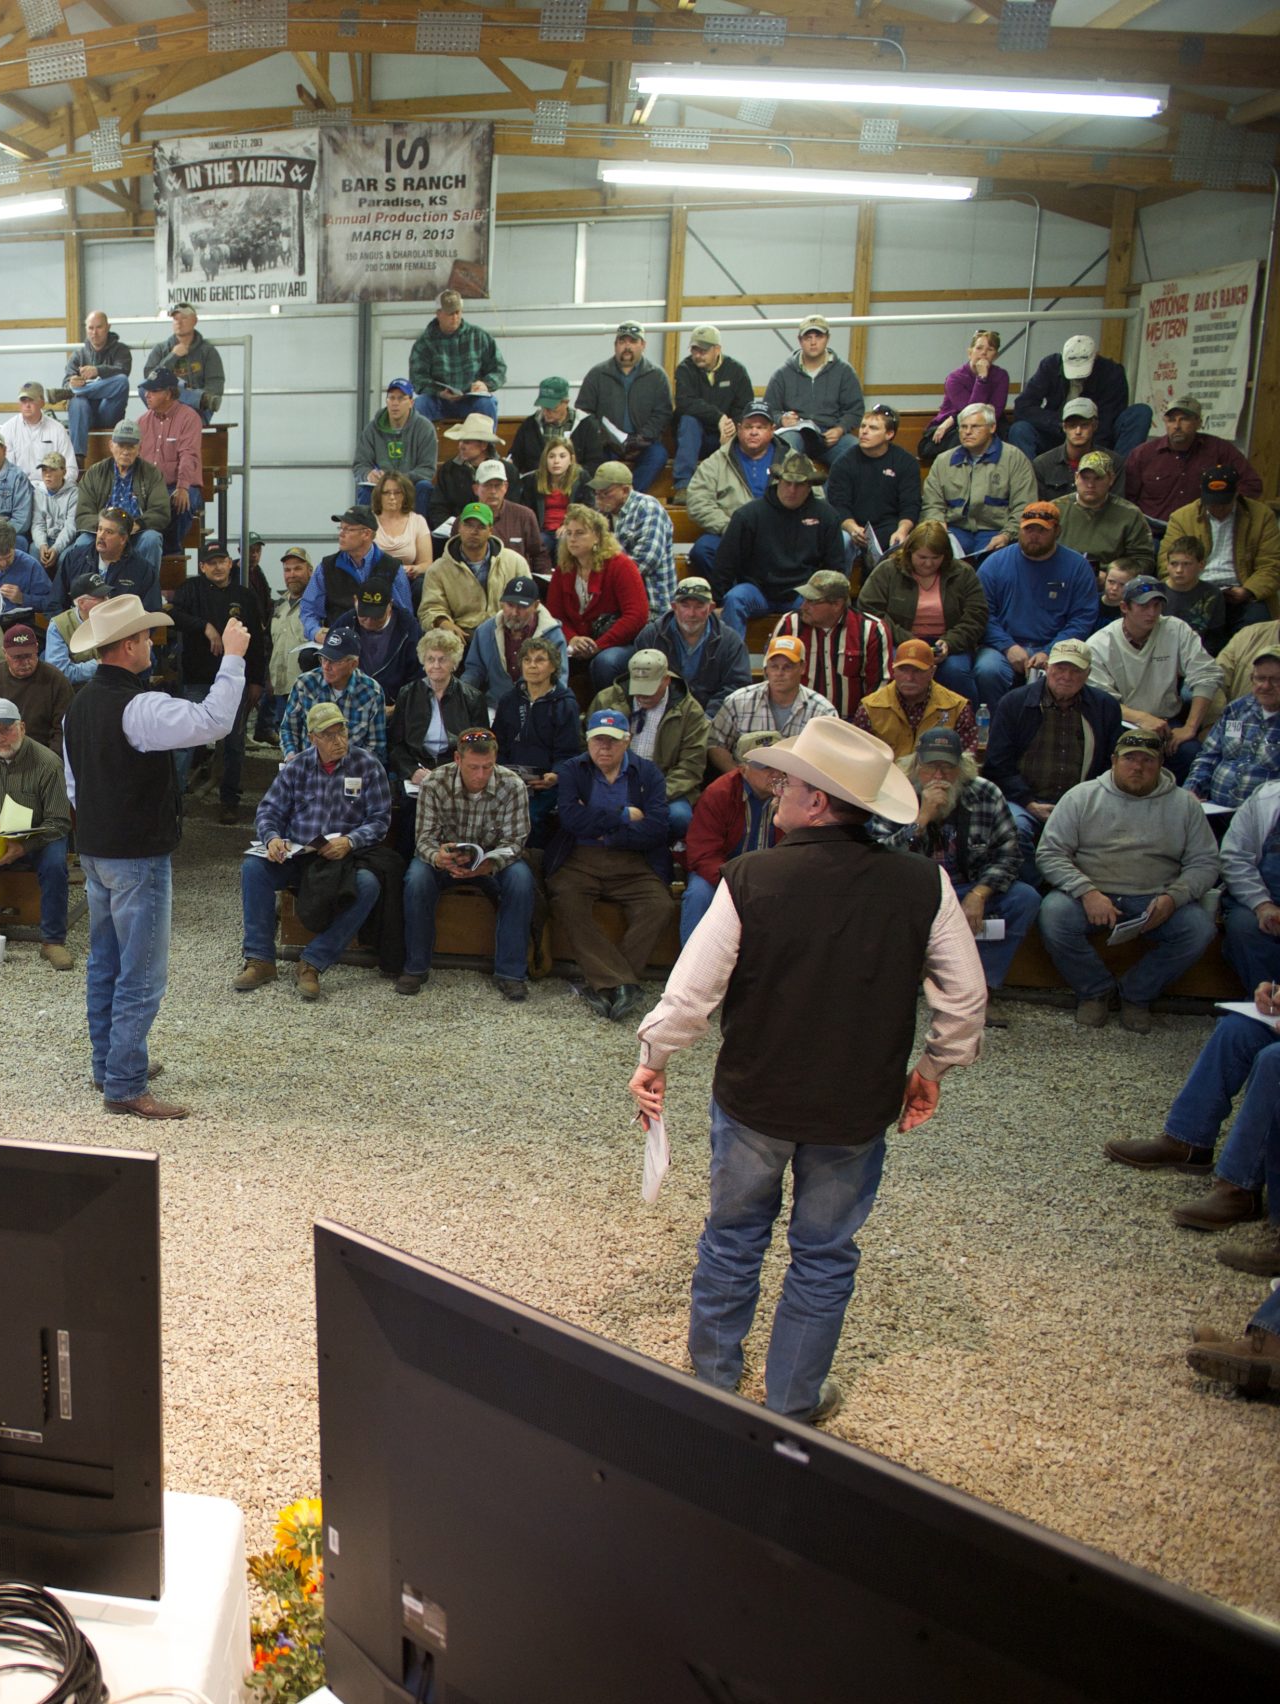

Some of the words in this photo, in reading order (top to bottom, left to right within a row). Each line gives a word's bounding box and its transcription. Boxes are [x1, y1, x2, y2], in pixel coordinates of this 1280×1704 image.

[208, 140, 231, 150] JANUARY
[184, 166, 203, 189] IN
[203, 160, 233, 187] THE
[236, 159, 287, 183] YARDS
[341, 178, 378, 193] BAR
[384, 177, 396, 192] S
[403, 174, 467, 192] RANCH
[358, 197, 425, 209] Paradise,
[429, 195, 448, 206] KS
[325, 211, 371, 226] Annual
[375, 211, 448, 224] Production
[452, 209, 483, 221] Sale
[351, 230, 401, 243] MARCH
[405, 229, 418, 241] 8,
[423, 228, 455, 240] 2013
[359, 251, 384, 260] ANGUS
[392, 250, 434, 259] CHAROLAIS
[435, 249, 458, 258] BULLS
[380, 262, 402, 271] COMM
[404, 261, 437, 271] FEMALES
[167, 288, 207, 303] MOVING
[210, 284, 256, 301] GENETICS
[258, 281, 308, 299] FORWARD
[1193, 292, 1211, 312] BAR
[1211, 290, 1218, 309] S
[1219, 285, 1249, 308] RANCH
[1148, 293, 1189, 319] NATIONAL
[1146, 317, 1188, 342] WESTERN
